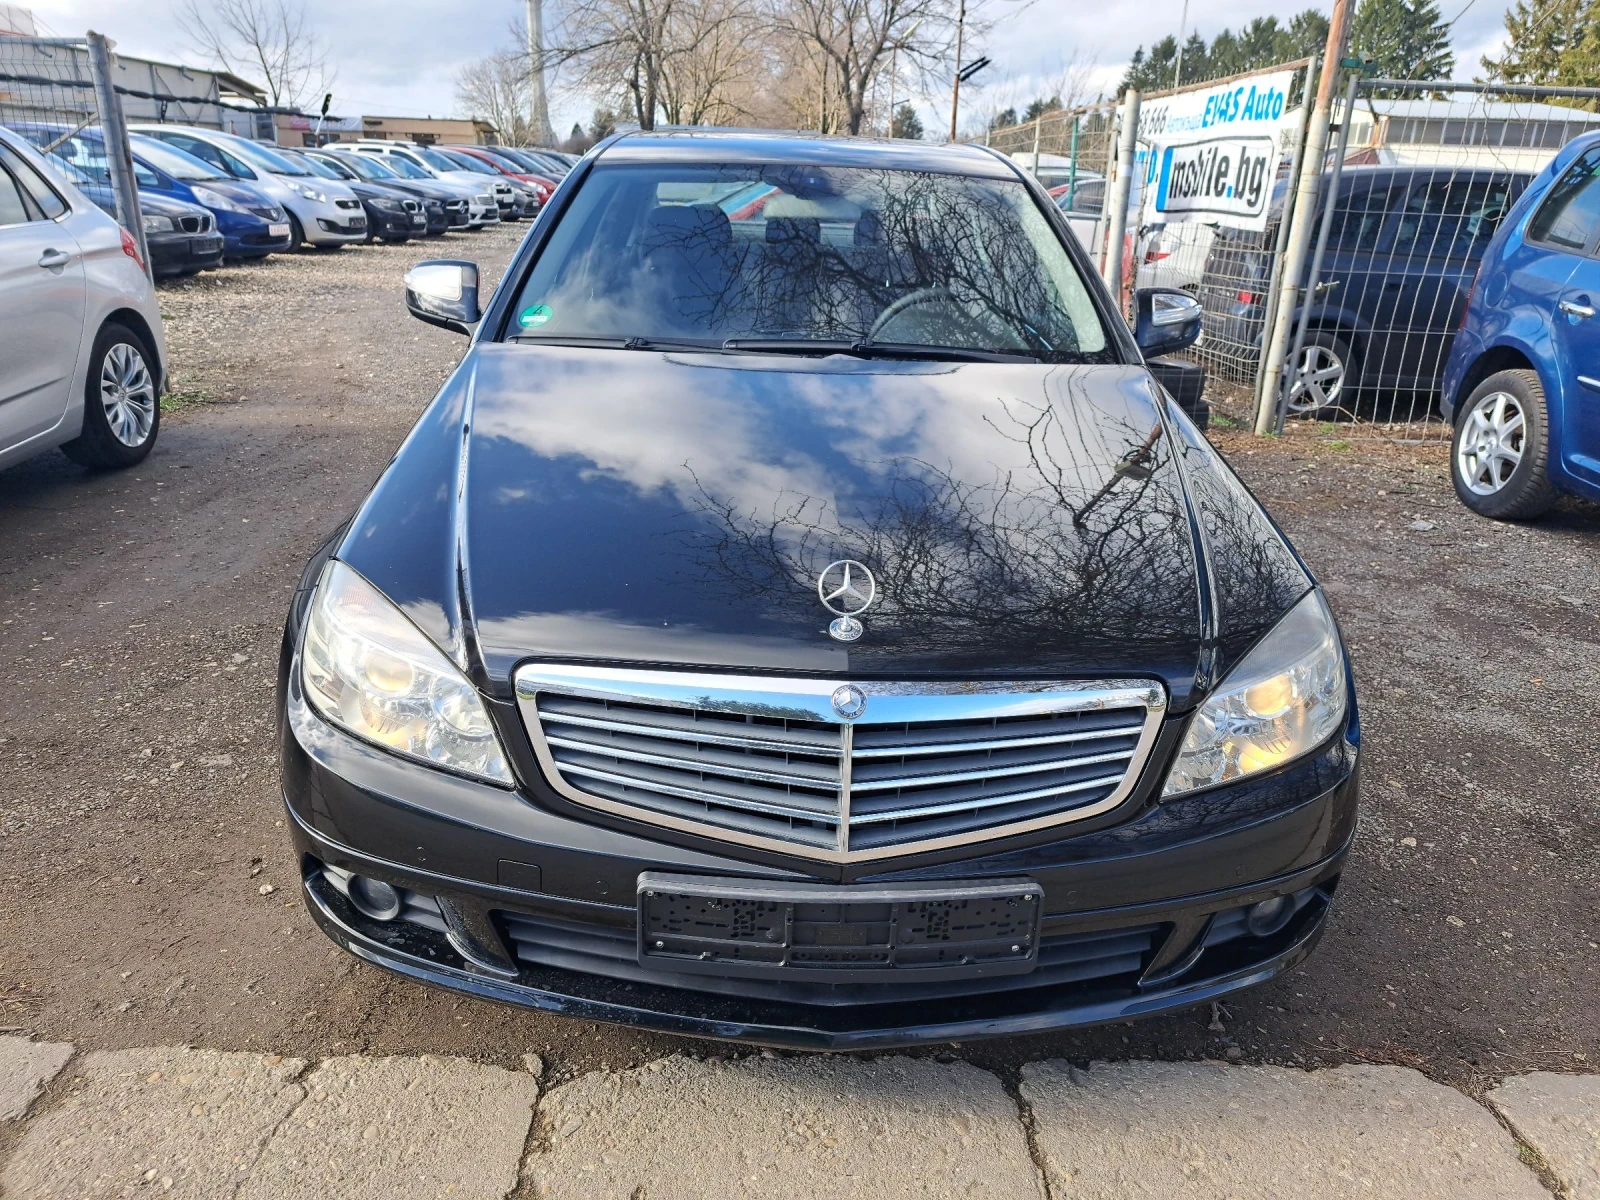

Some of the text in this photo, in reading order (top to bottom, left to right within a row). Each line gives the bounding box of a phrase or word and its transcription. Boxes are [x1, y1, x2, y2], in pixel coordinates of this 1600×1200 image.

[1241, 85, 1283, 120] Auto
[1169, 146, 1267, 208] mobile.bg
[533, 304, 544, 316] 4
